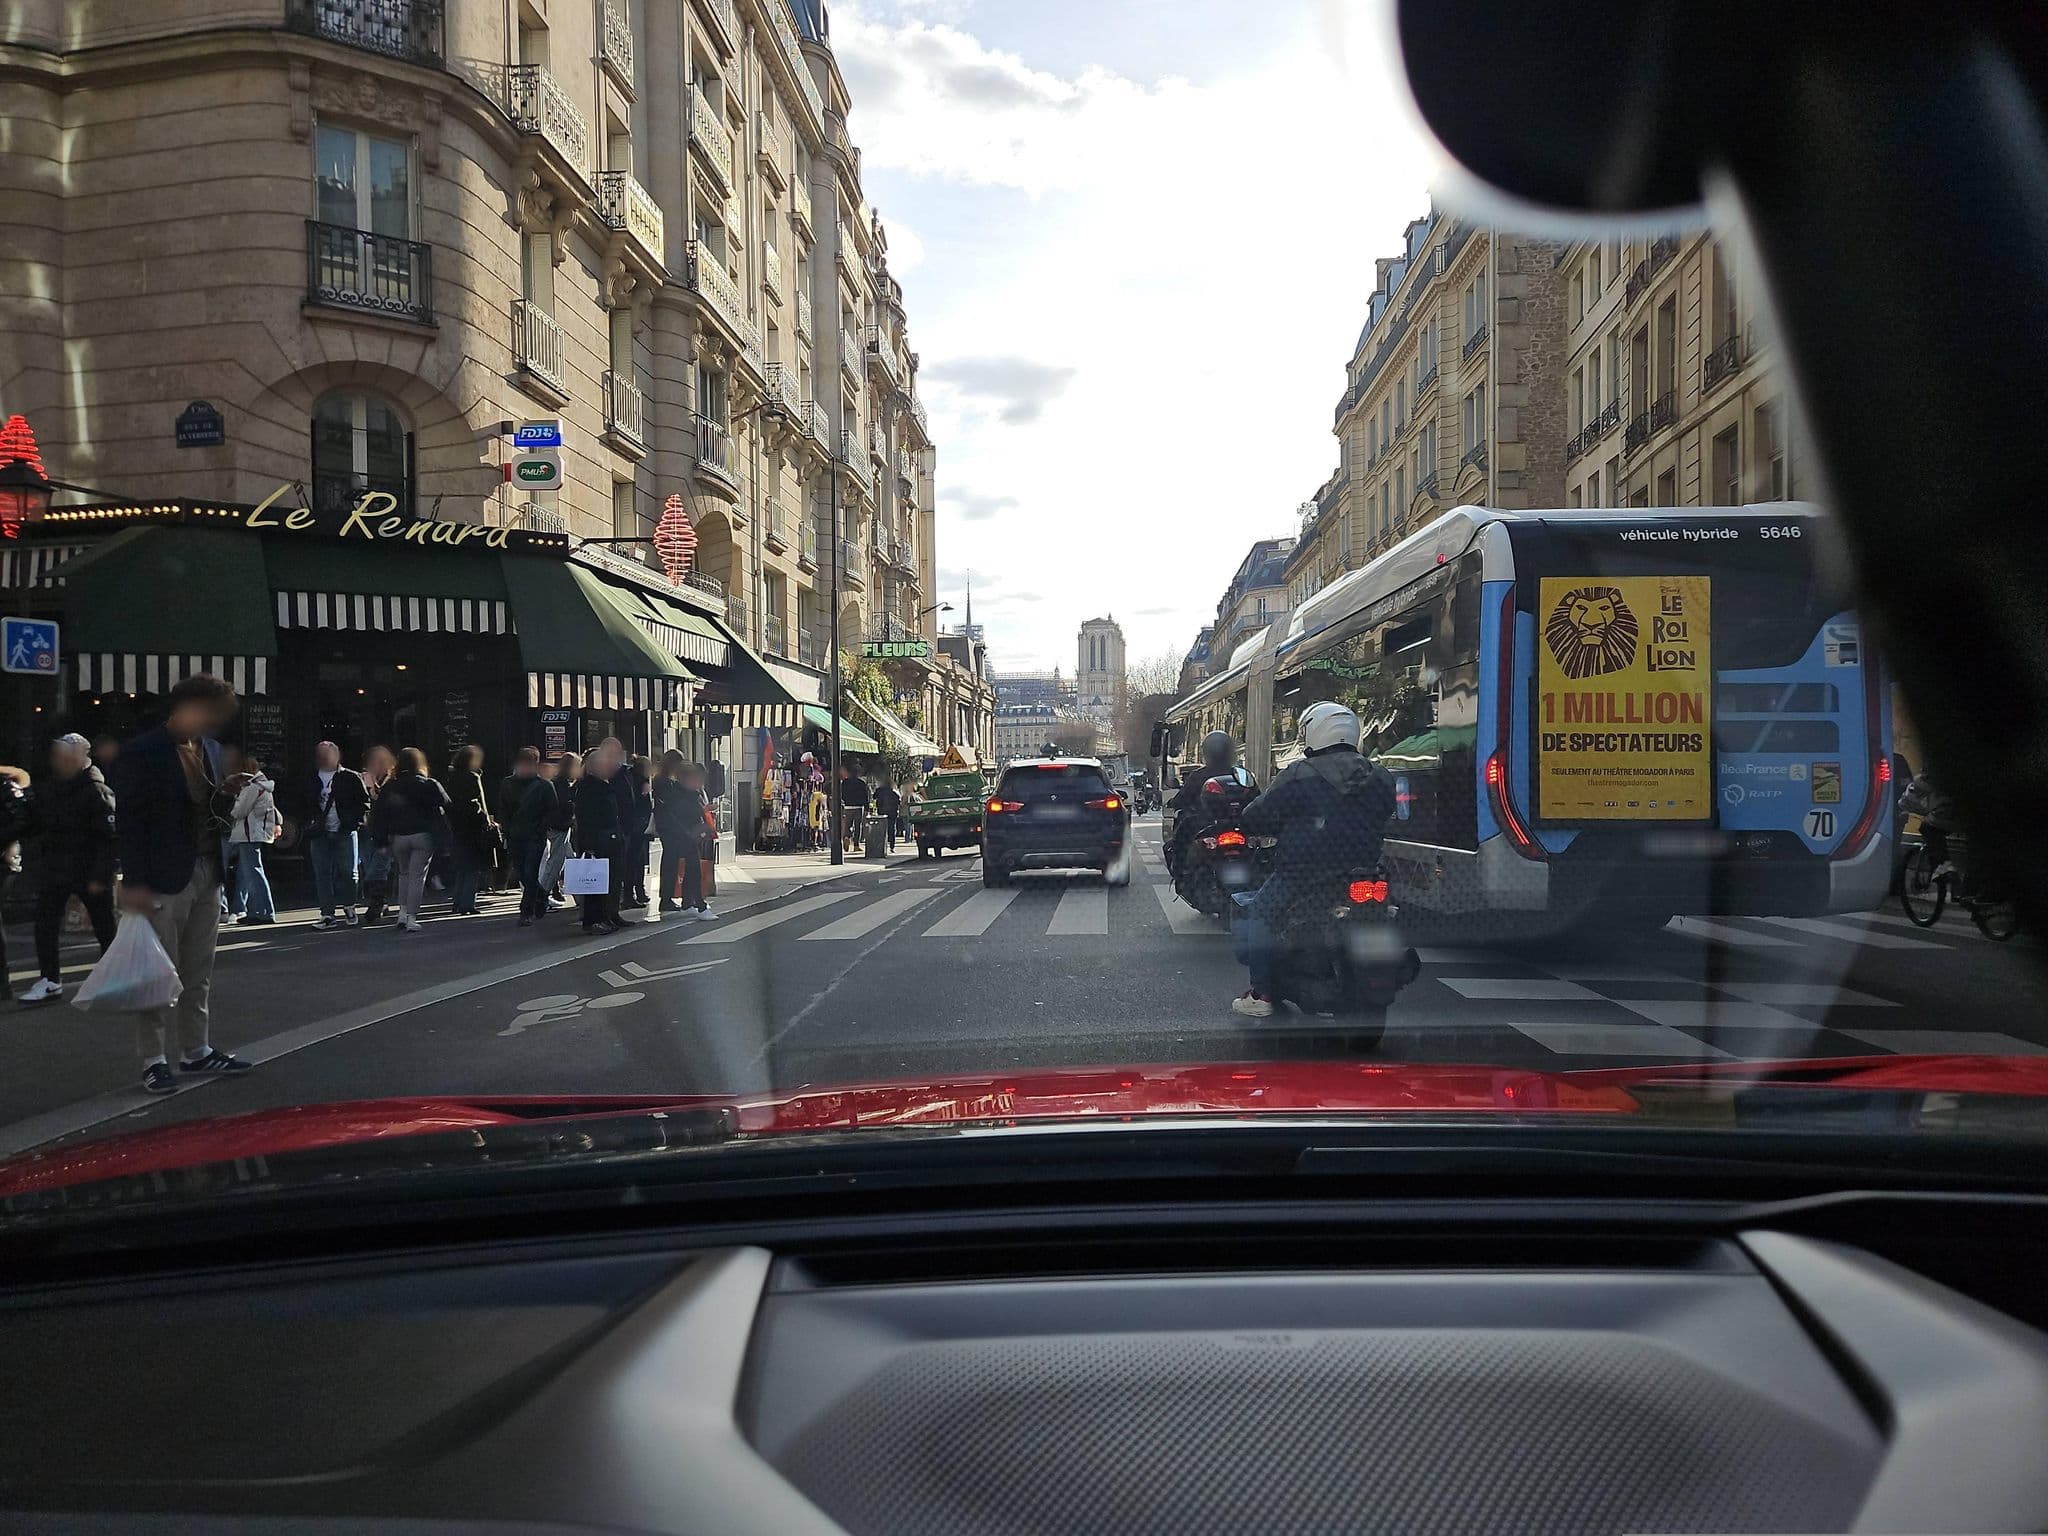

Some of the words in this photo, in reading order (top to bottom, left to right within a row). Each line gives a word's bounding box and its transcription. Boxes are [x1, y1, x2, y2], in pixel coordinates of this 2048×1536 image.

[520, 428, 542, 438] FDJ
[520, 468, 540, 476] PMU
[246, 484, 316, 530] Le
[339, 491, 526, 549] Renard
[1620, 529, 1679, 541] véhicule
[1683, 528, 1739, 542] hybride
[1760, 526, 1801, 539] 5646
[1661, 595, 1682, 612] LE
[1653, 616, 1688, 643] ROI
[862, 642, 928, 657] FLEURS
[1647, 644, 1695, 672] LION
[1543, 692, 1557, 723] 1
[1564, 691, 1703, 724] MILLION
[1542, 732, 1566, 752] DE
[1569, 732, 1703, 753] SPECTATEURS
[1551, 768, 1591, 776] SEULEMENT
[1592, 768, 1602, 776] AU
[1633, 768, 1668, 776] MOGADOR
[1675, 768, 1695, 776] PARIS
[1809, 812, 1834, 838] 70
